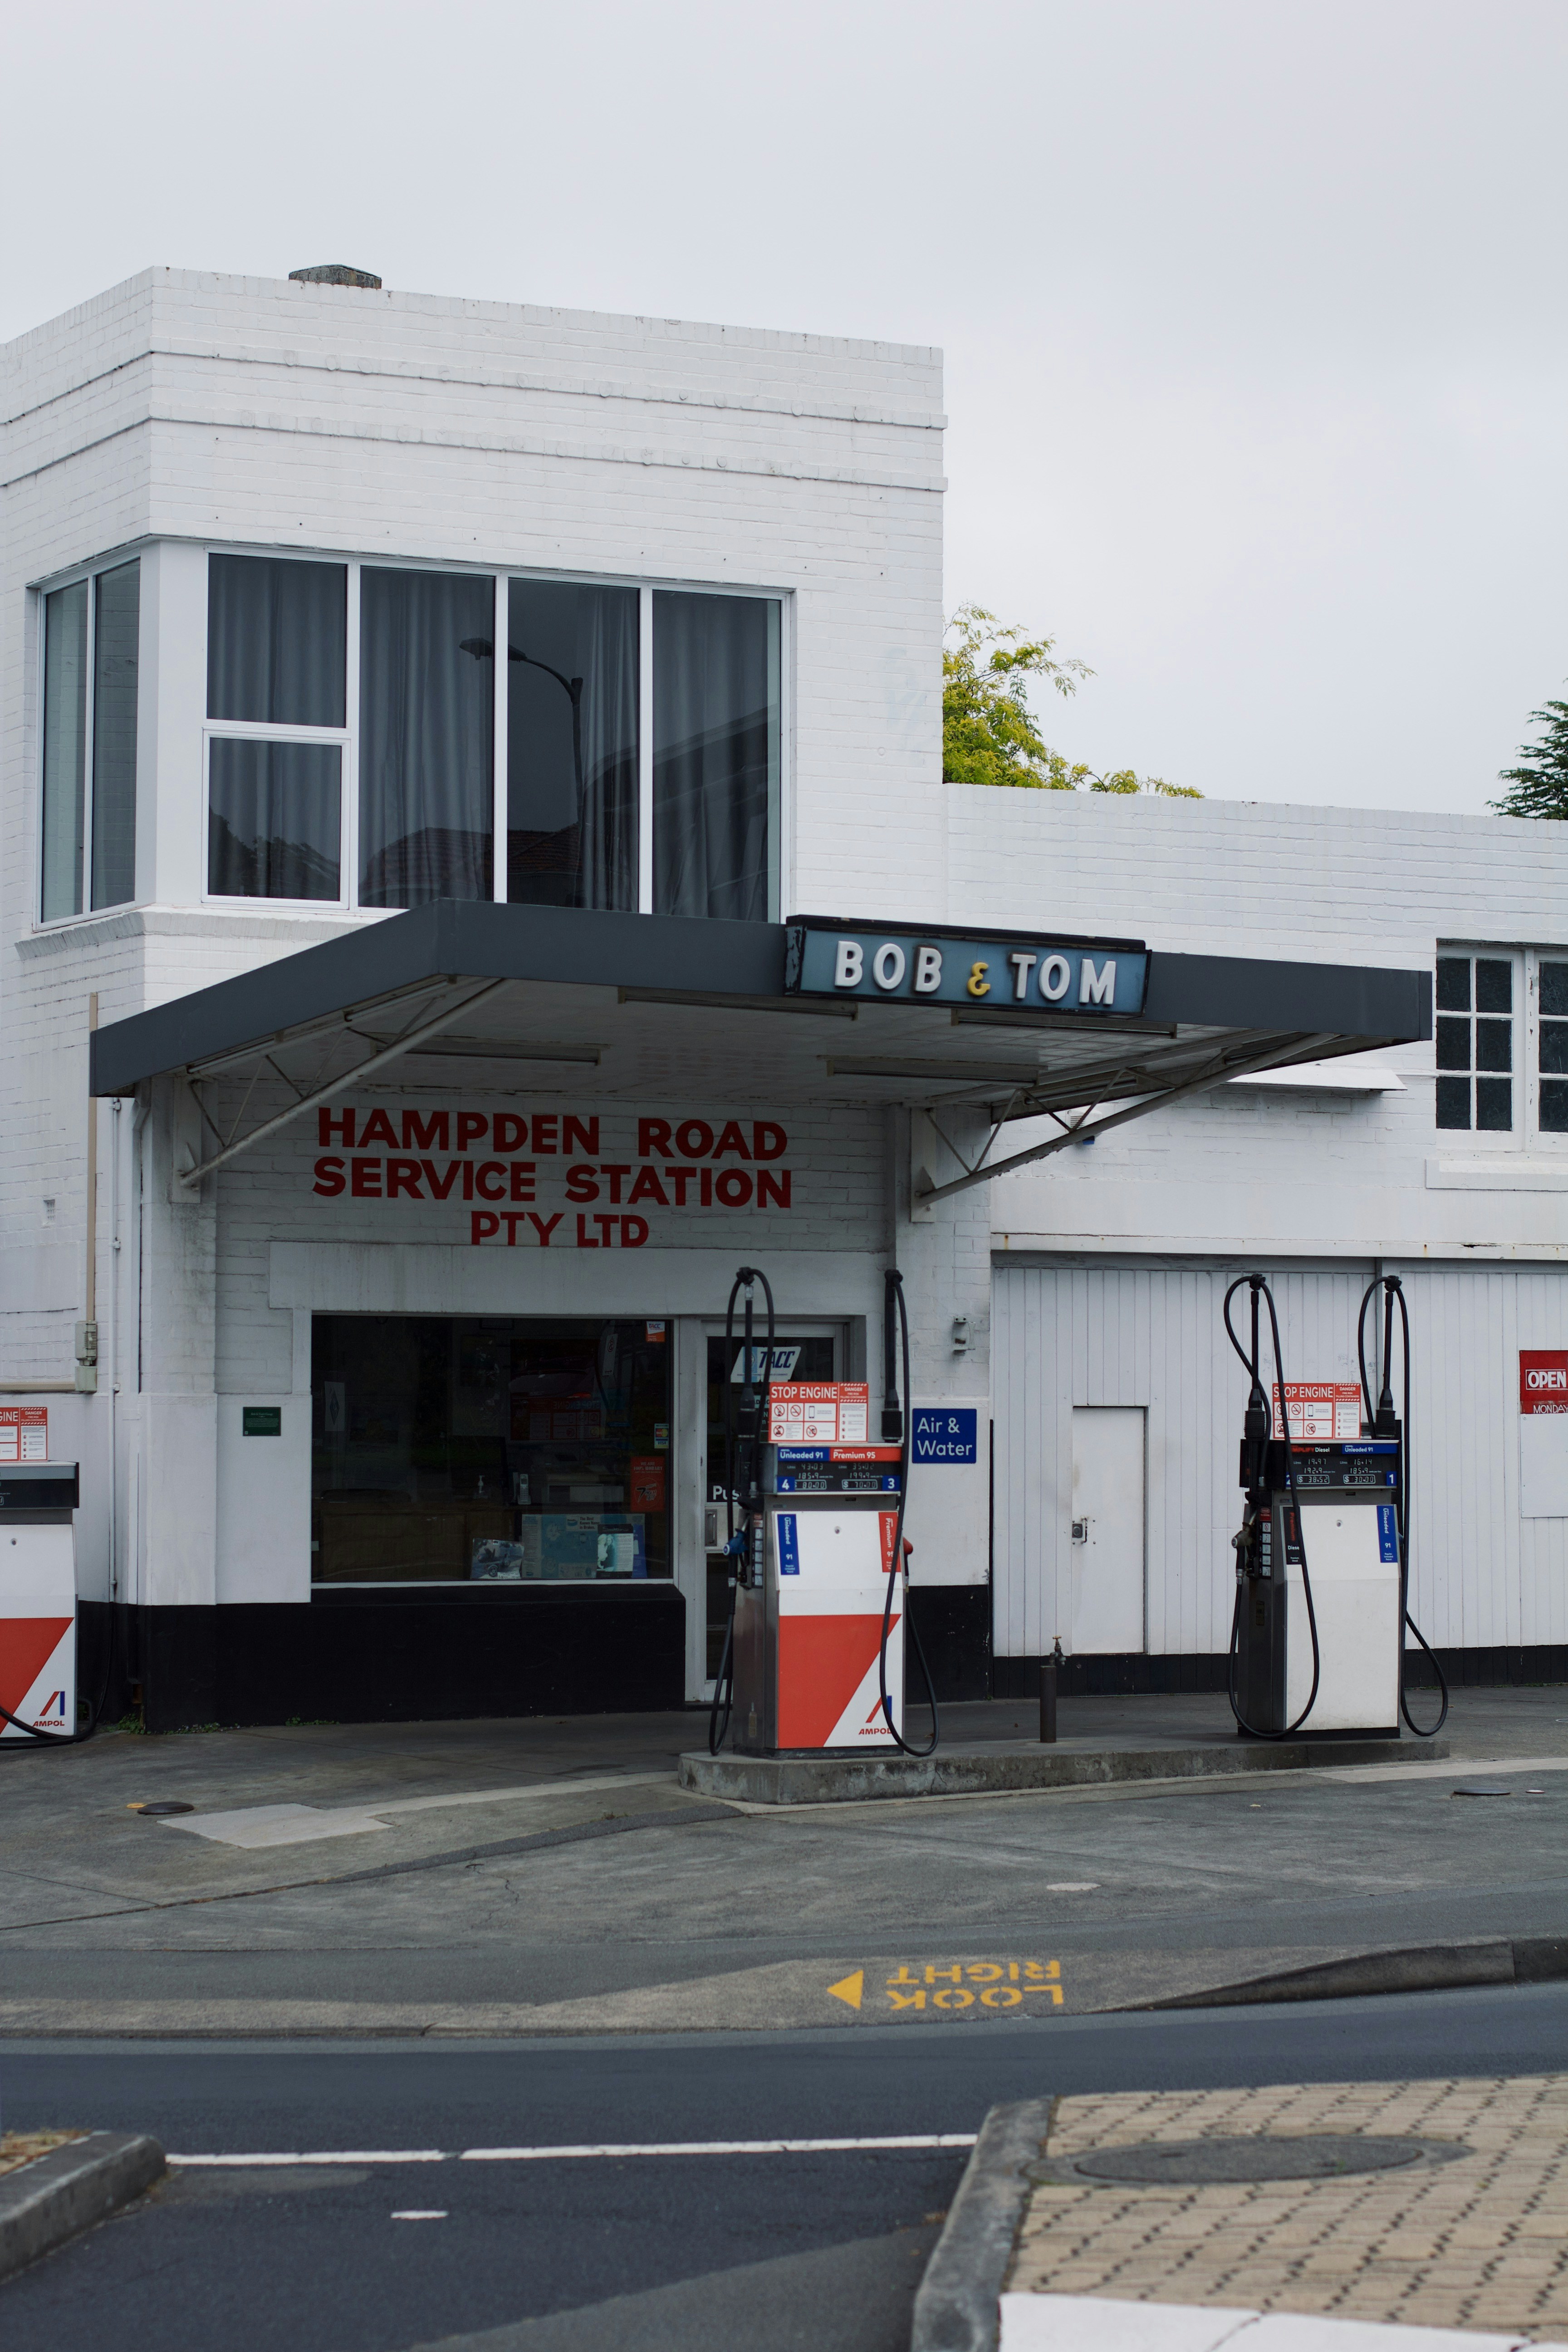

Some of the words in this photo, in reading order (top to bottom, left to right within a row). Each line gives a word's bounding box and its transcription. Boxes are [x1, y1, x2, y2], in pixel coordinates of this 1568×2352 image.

[834, 940, 942, 993] BOB
[967, 961, 991, 996] &
[1010, 953, 1116, 1005] TOM
[318, 1107, 599, 1155] HAMPDEN
[637, 1117, 787, 1161] ROAD
[312, 1156, 536, 1202] SERVICE
[564, 1164, 791, 1208] STATION
[470, 1210, 564, 1246] PTY
[576, 1213, 649, 1248] LTD
[1528, 1371, 1567, 1388] OPEN
[771, 1387, 797, 1399] STOP
[799, 1387, 838, 1399] ENGINE
[1274, 1386, 1297, 1398] SOP
[1299, 1387, 1333, 1398] ENGINE
[917, 1417, 943, 1433] Air
[947, 1417, 960, 1433] &
[917, 1440, 973, 1456] Water
[781, 1479, 790, 1490] 4
[887, 1478, 895, 1490] 3
[1389, 1474, 1394, 1484] 1
[886, 1960, 1061, 1984] RIGHT
[886, 1984, 1064, 2010] LOOK
